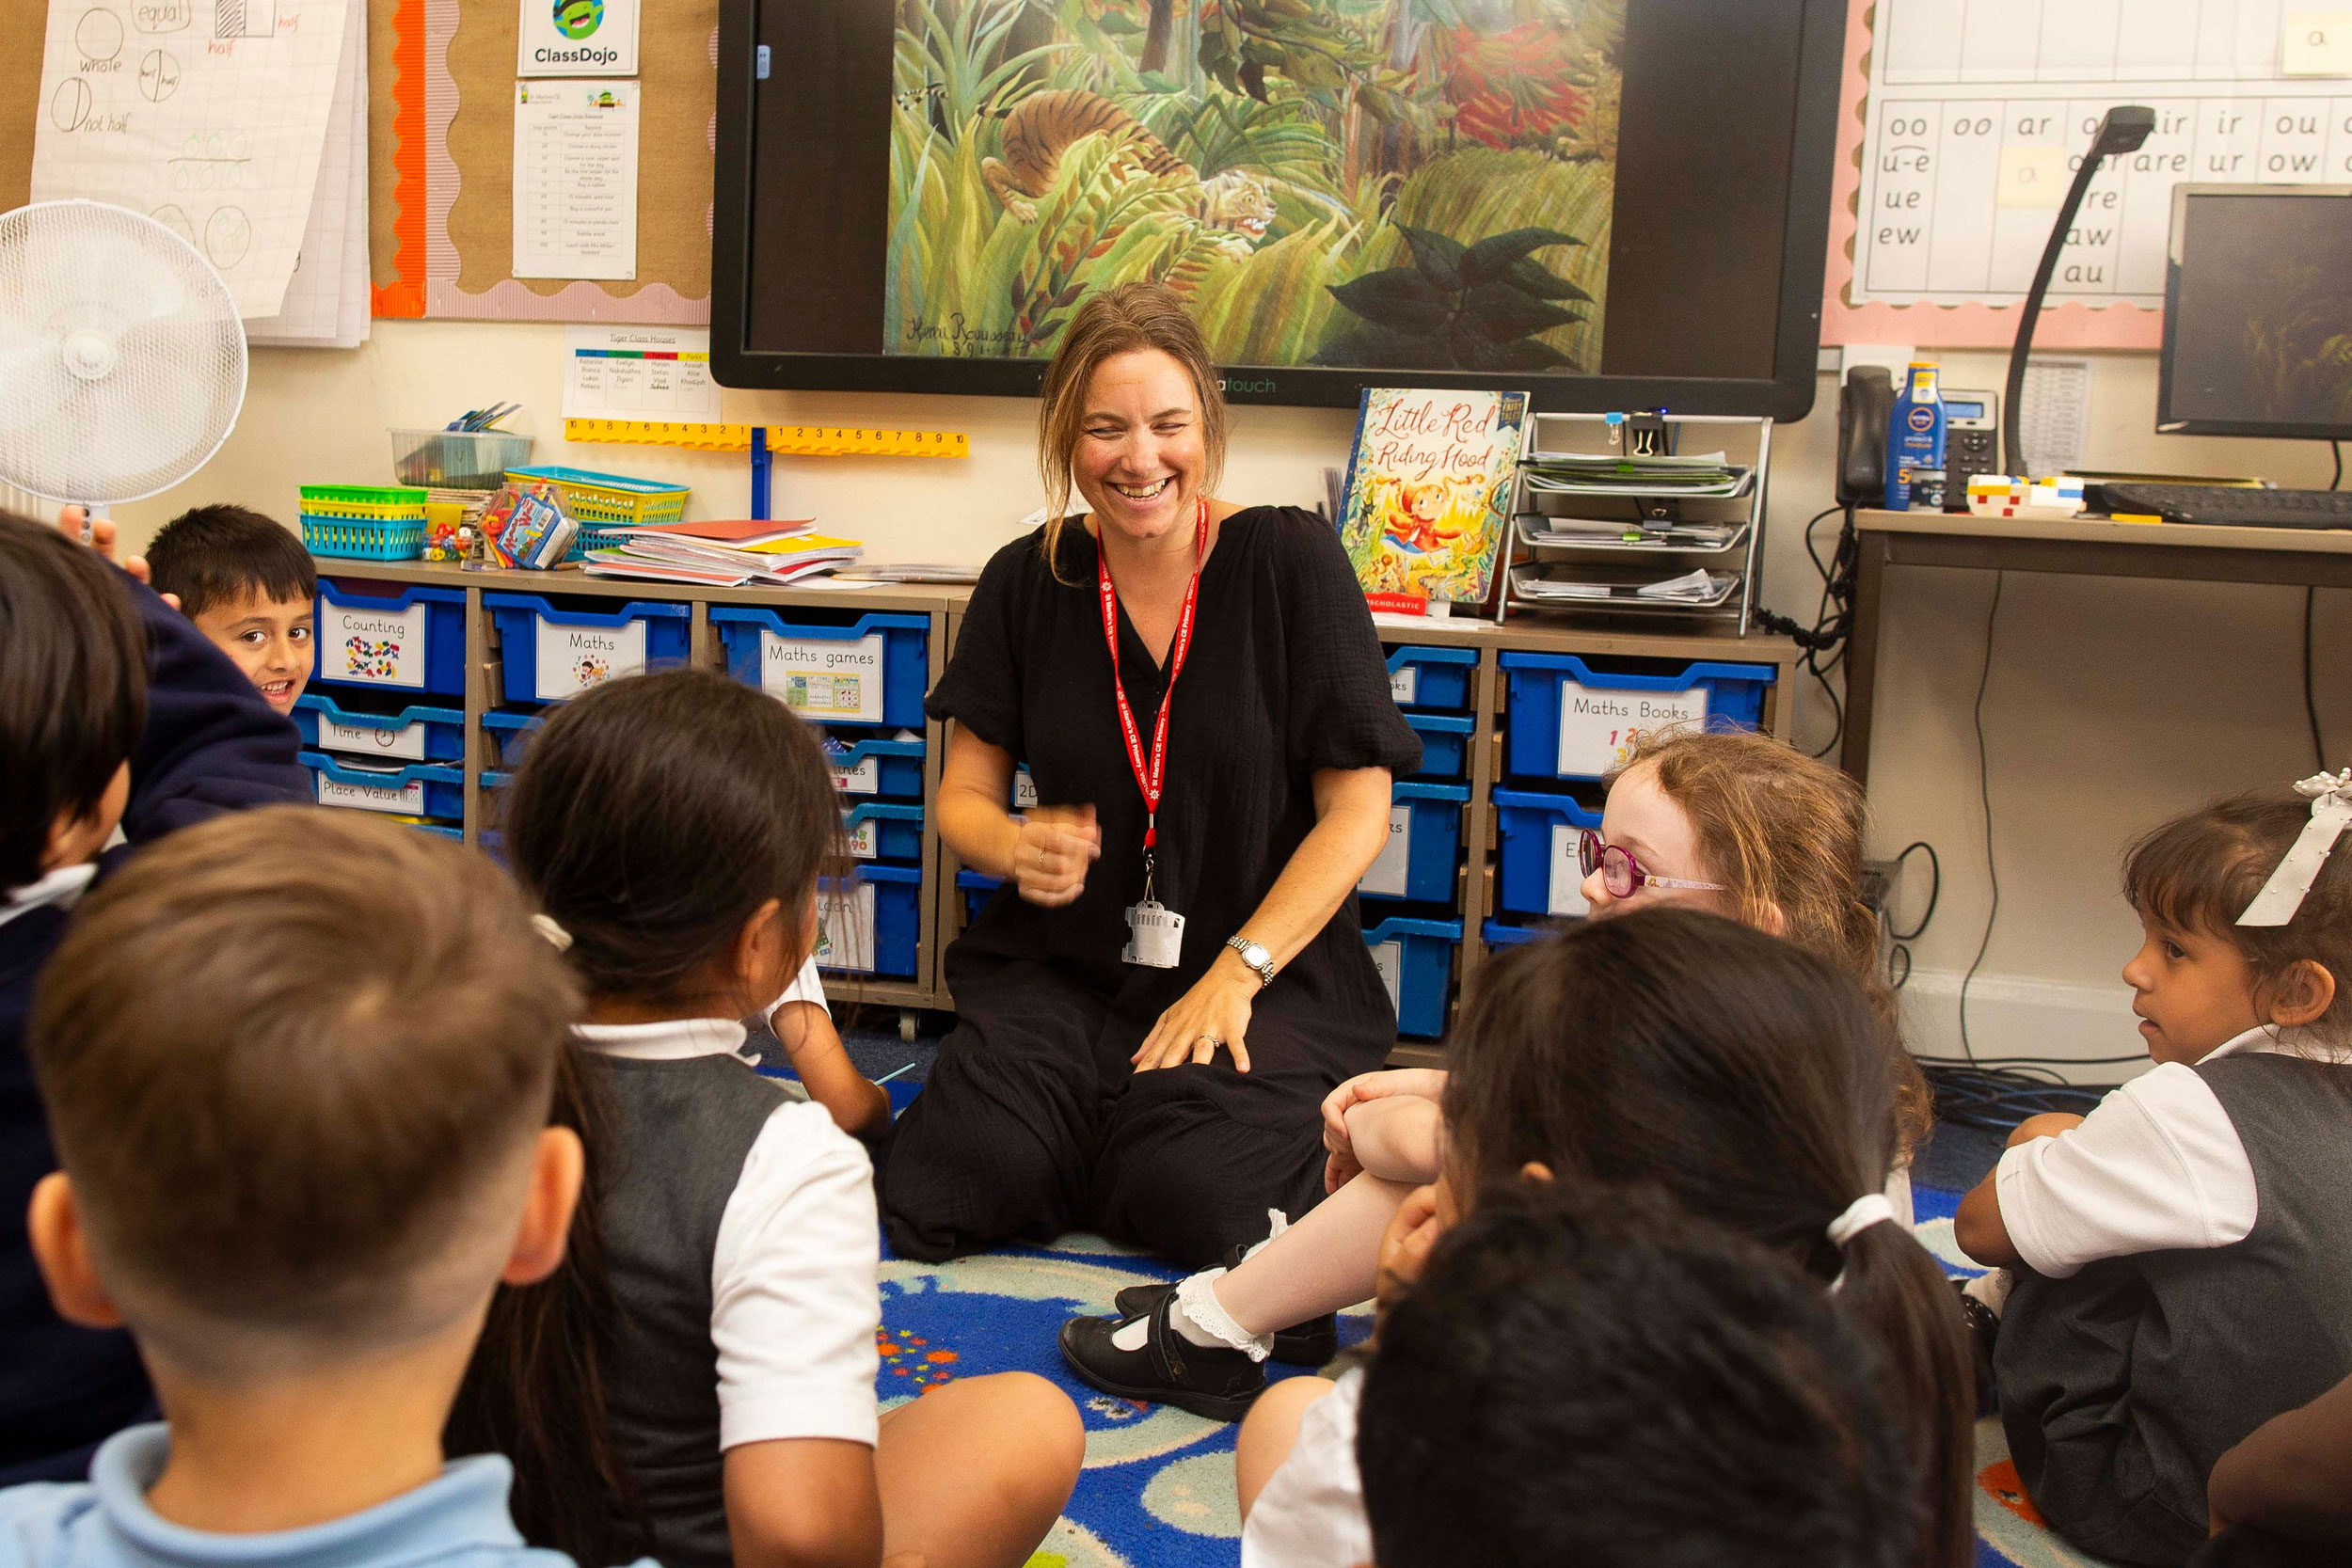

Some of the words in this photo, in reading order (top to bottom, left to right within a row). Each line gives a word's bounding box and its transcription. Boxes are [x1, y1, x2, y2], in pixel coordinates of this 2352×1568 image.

[137, 0, 183, 31] equal
[278, 13, 300, 35] half
[207, 40, 236, 56] half
[534, 46, 618, 66] ClassDojo
[79, 57, 122, 73] whole
[106, 111, 134, 136] half
[1890, 118, 1928, 136] oo
[1953, 118, 1994, 136] oo
[2017, 117, 2052, 135] ar
[2217, 110, 2243, 135] ir
[2275, 115, 2317, 135] ou
[1883, 154, 1931, 173] u-e
[2133, 153, 2187, 173] are
[2209, 153, 2245, 172] ur
[2266, 153, 2318, 172] ow
[1884, 191, 1922, 209] ue
[2087, 191, 2118, 210] re
[1878, 227, 1922, 245] ew
[2062, 227, 2113, 246] aw
[2064, 264, 2104, 283] au
[610, 333, 628, 344] Tiger
[650, 334, 676, 345] Houses
[570, 420, 578, 429] 10
[588, 420, 595, 430] 9
[606, 421, 613, 430] 8
[625, 422, 631, 431] 7
[644, 422, 650, 432] 6
[663, 423, 669, 432] 5
[682, 423, 688, 433] 4
[700, 424, 707, 434] 3
[720, 425, 726, 435] 2
[740, 426, 745, 435] 1
[1373, 397, 1440, 440] Little
[1440, 402, 1497, 444] Red
[779, 428, 783, 437] 1
[797, 428, 803, 437] 2
[816, 429, 823, 438] 3
[836, 429, 842, 439] 4
[856, 430, 863, 440] 5
[875, 431, 882, 441] 6
[896, 432, 903, 442] 7
[915, 433, 922, 443] 8
[936, 434, 943, 443] 9
[956, 434, 964, 444] 10
[1376, 440, 1438, 482] Riding
[1439, 442, 1494, 475] Hood
[1369, 598, 1421, 610] SCHOLASTIC
[1181, 604, 1192, 629] Primary
[342, 614, 405, 641] Counting
[1180, 629, 1188, 641] CE
[569, 632, 615, 652] Maths
[769, 644, 818, 663] Maths
[825, 653, 875, 670] games
[1573, 697, 1630, 718] Maths
[1639, 701, 1690, 721] Books
[331, 723, 362, 740] Time
[1129, 733, 1138, 744] CE
[1156, 717, 1167, 742] Primary
[1132, 744, 1144, 768] Primary
[1155, 742, 1163, 754] CE
[1152, 753, 1162, 778] Martin's
[323, 781, 357, 799] Place
[361, 785, 398, 801] Value
[817, 897, 853, 914] icon
